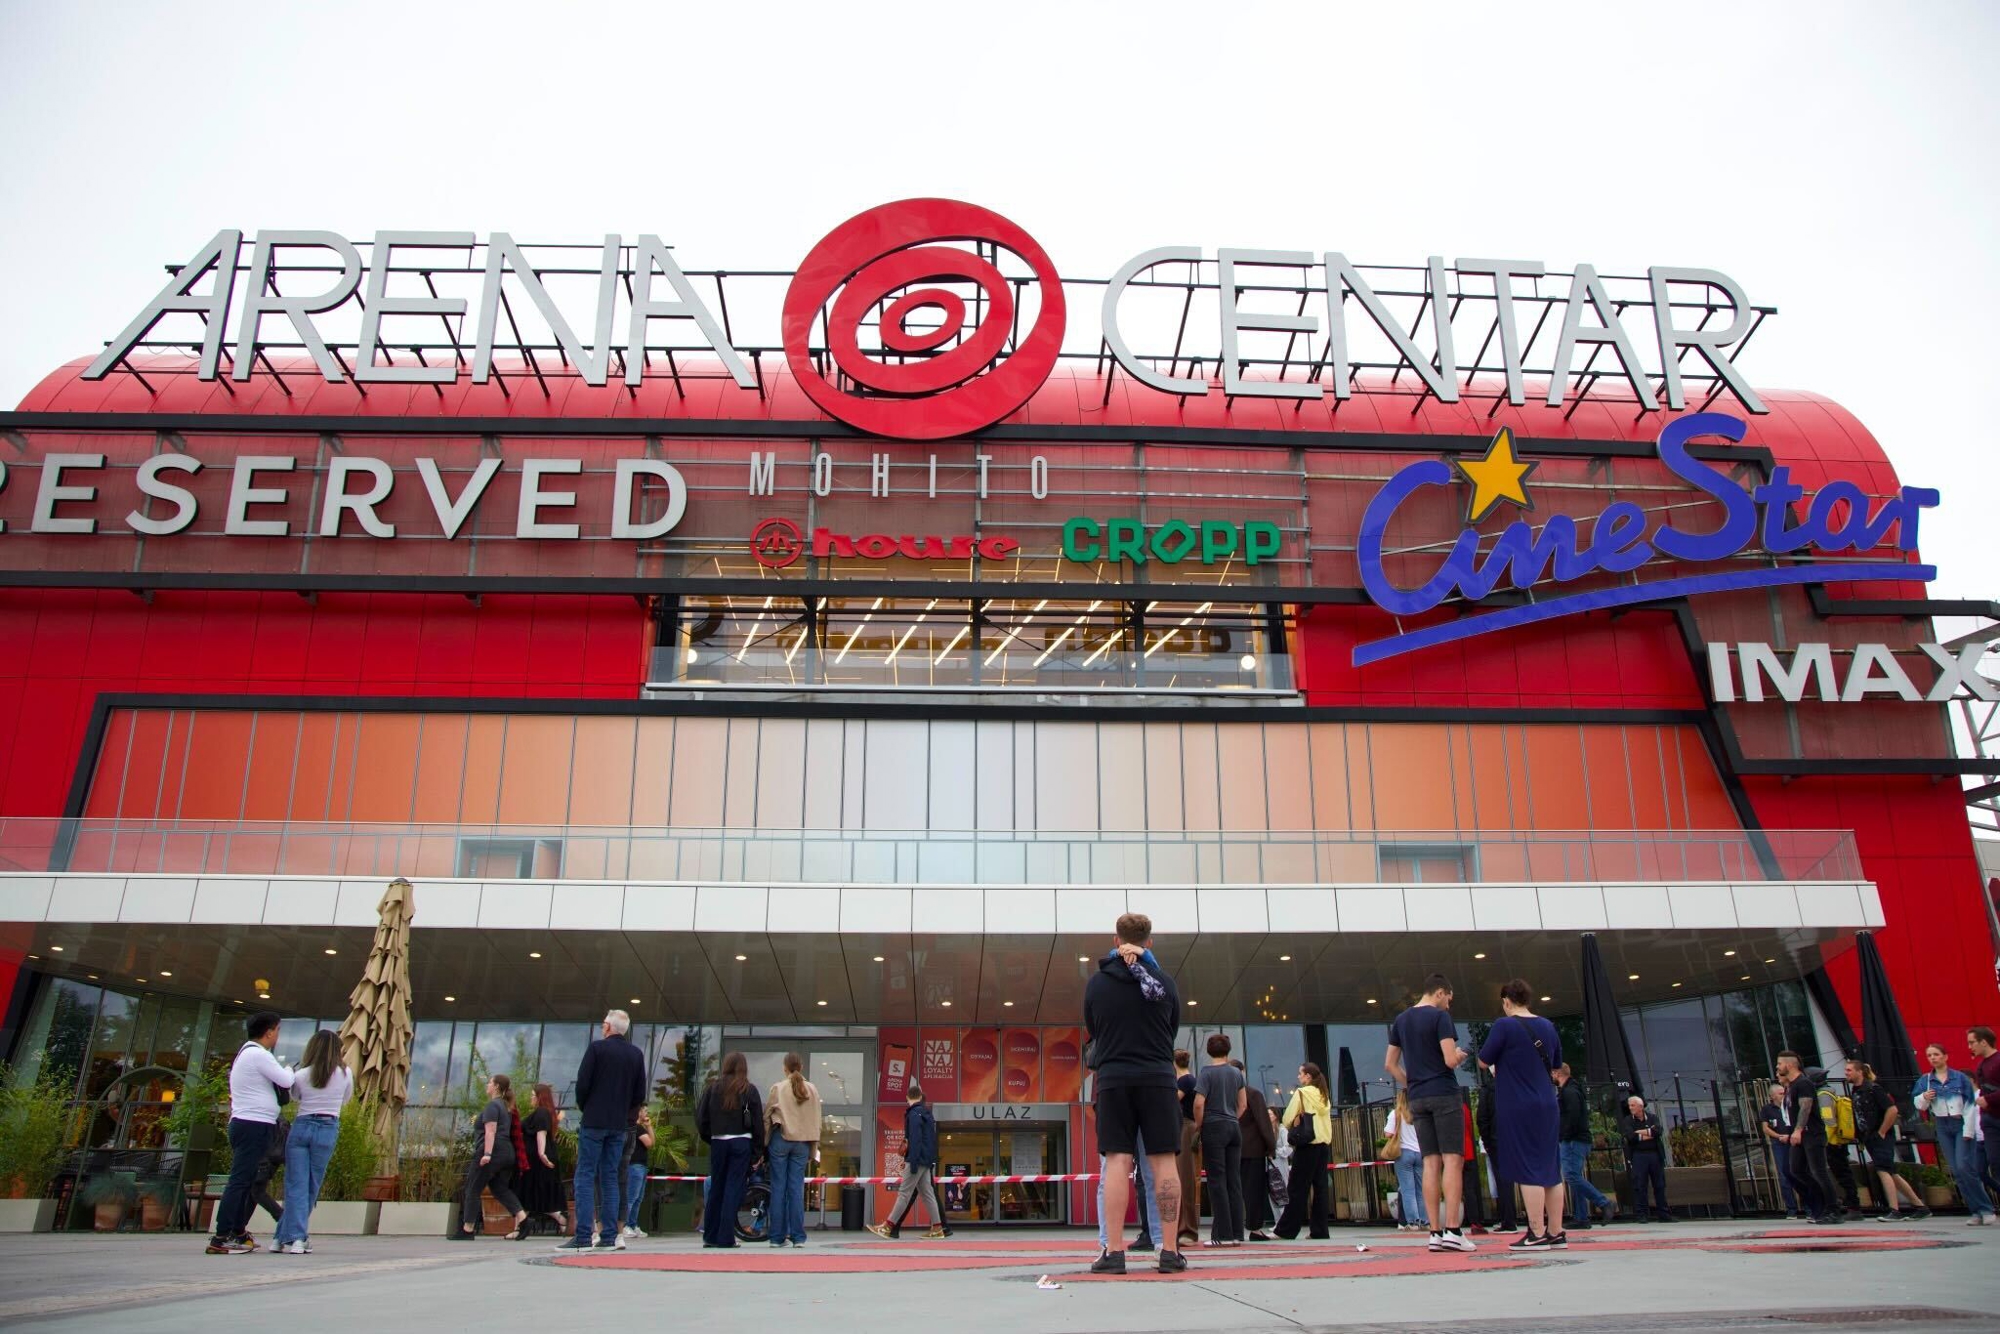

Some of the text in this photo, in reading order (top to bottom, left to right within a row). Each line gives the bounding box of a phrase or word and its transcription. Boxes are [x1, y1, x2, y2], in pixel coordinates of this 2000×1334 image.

[80, 228, 1769, 416] ARENA CENTAR
[0, 452, 689, 541] ESERVED
[749, 451, 1049, 500] MOHITO
[1357, 411, 1941, 617] CineStar
[1062, 517, 1283, 567] CROPP
[1707, 641, 2000, 703] IMAX
[923, 1040, 954, 1053] NAJ
[923, 1053, 954, 1067] NAJ
[923, 1067, 953, 1075] LOYALTY
[973, 1106, 1032, 1120] ULAZ
